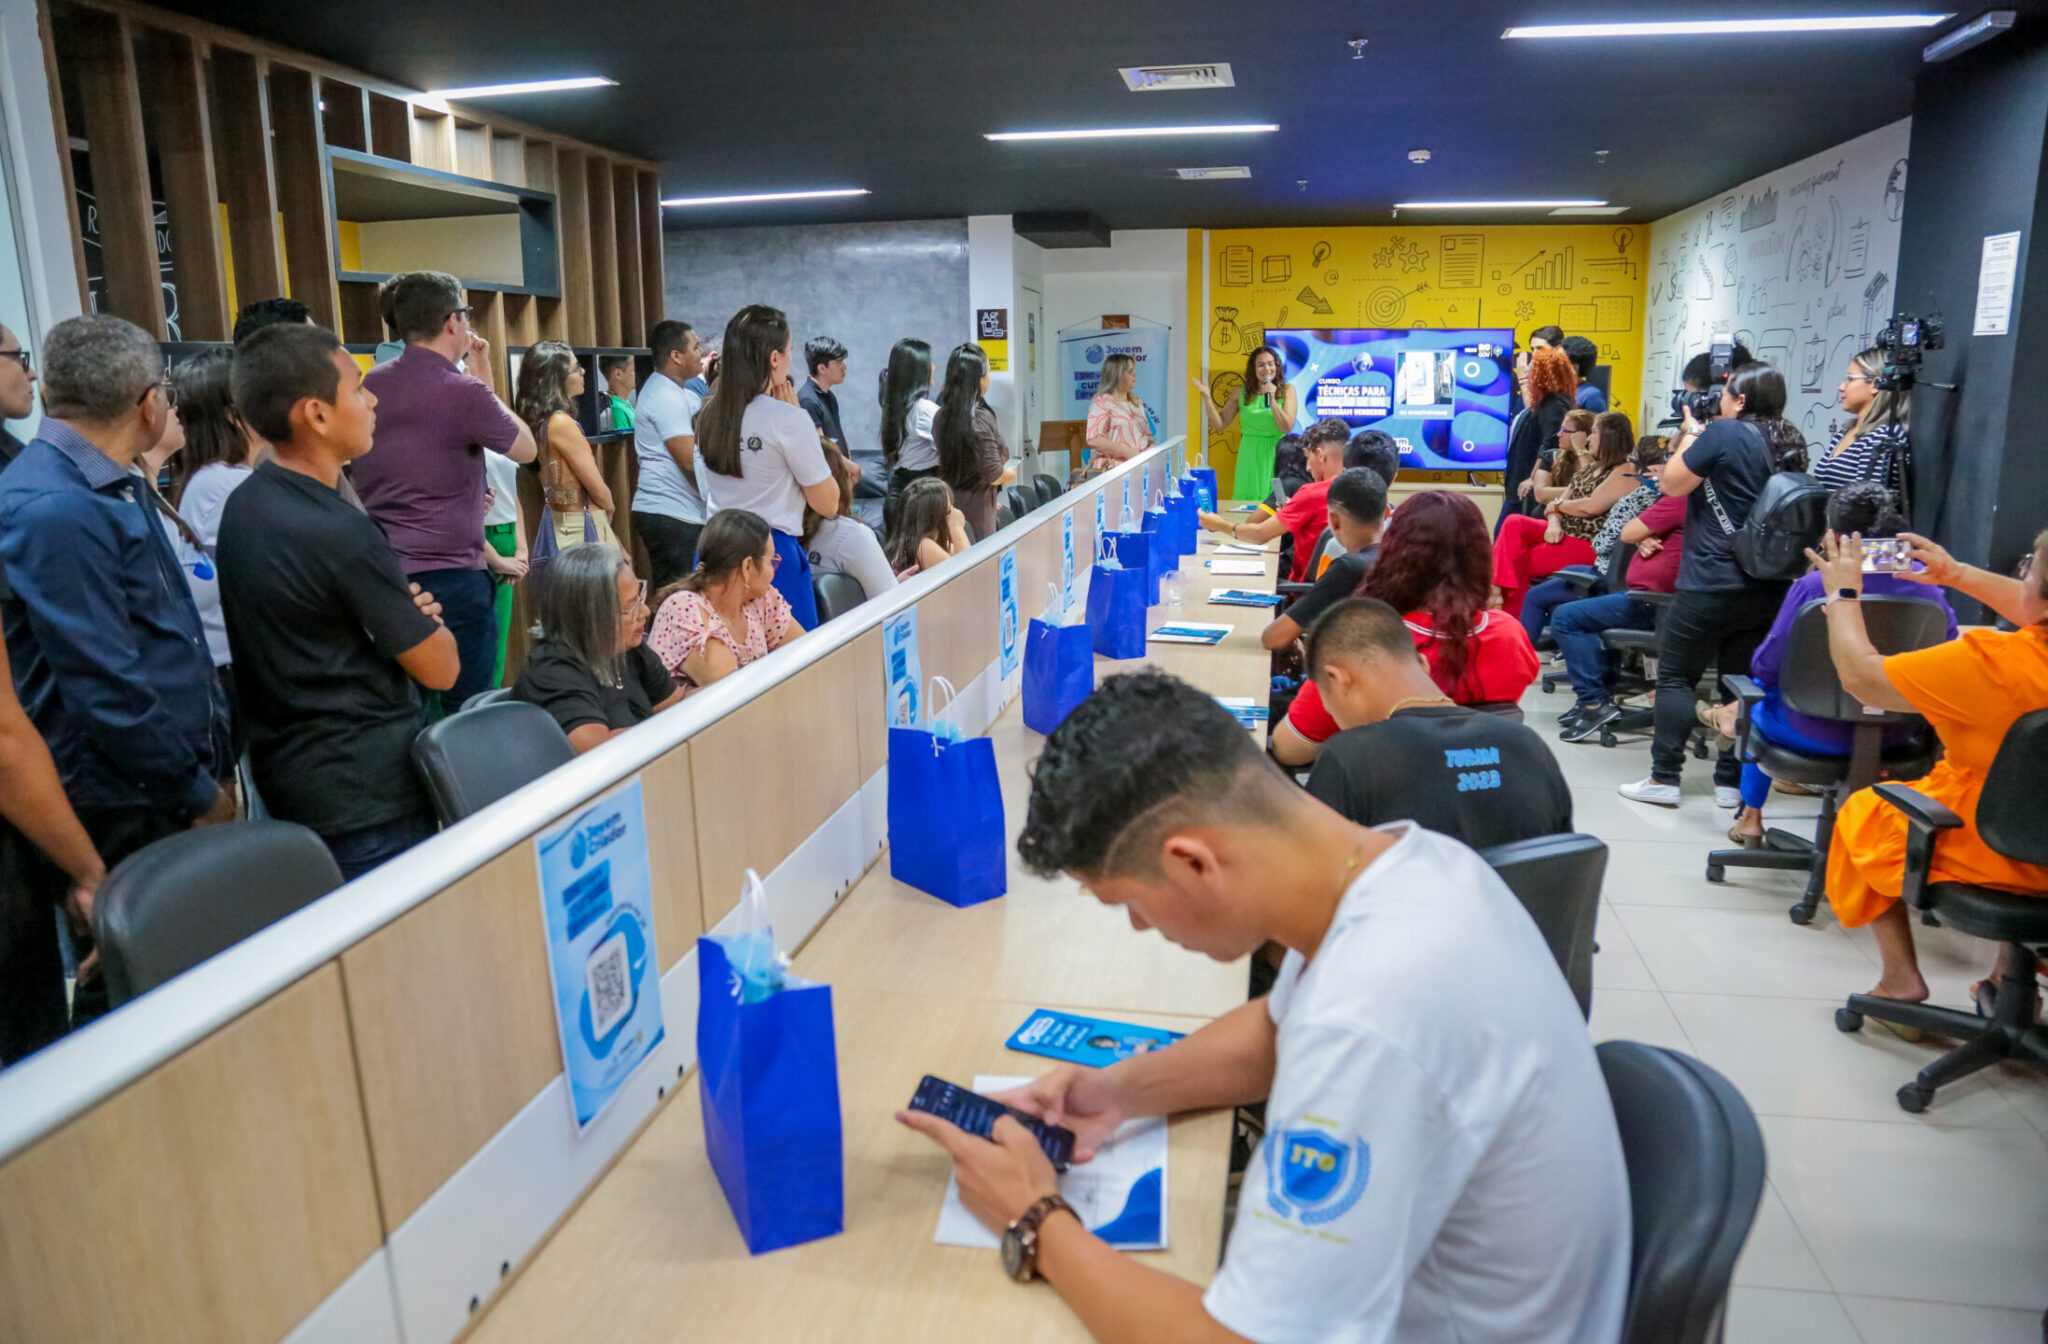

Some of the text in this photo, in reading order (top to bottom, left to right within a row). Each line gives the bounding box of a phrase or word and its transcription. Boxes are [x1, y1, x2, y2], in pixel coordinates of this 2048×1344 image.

[1105, 345, 1142, 354] Jovem
[1318, 385, 1386, 396] TÉCNICAS PARA
